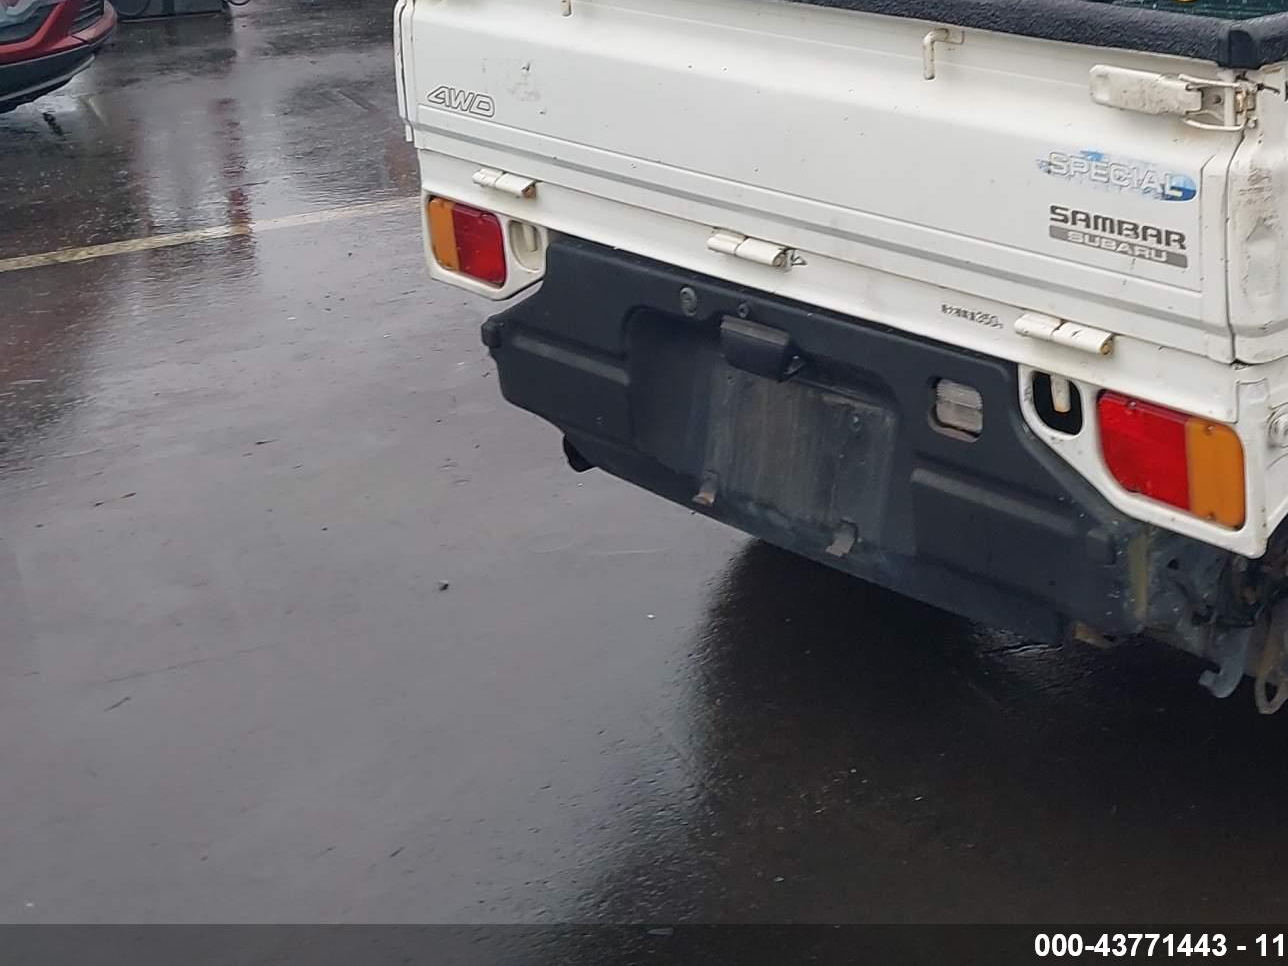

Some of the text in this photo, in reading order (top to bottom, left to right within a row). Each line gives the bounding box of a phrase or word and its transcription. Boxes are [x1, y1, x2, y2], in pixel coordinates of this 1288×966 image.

[1049, 151, 1184, 197] SPECIAL
[1049, 205, 1187, 251] SAMBAR
[1066, 231, 1168, 262] SUBARU
